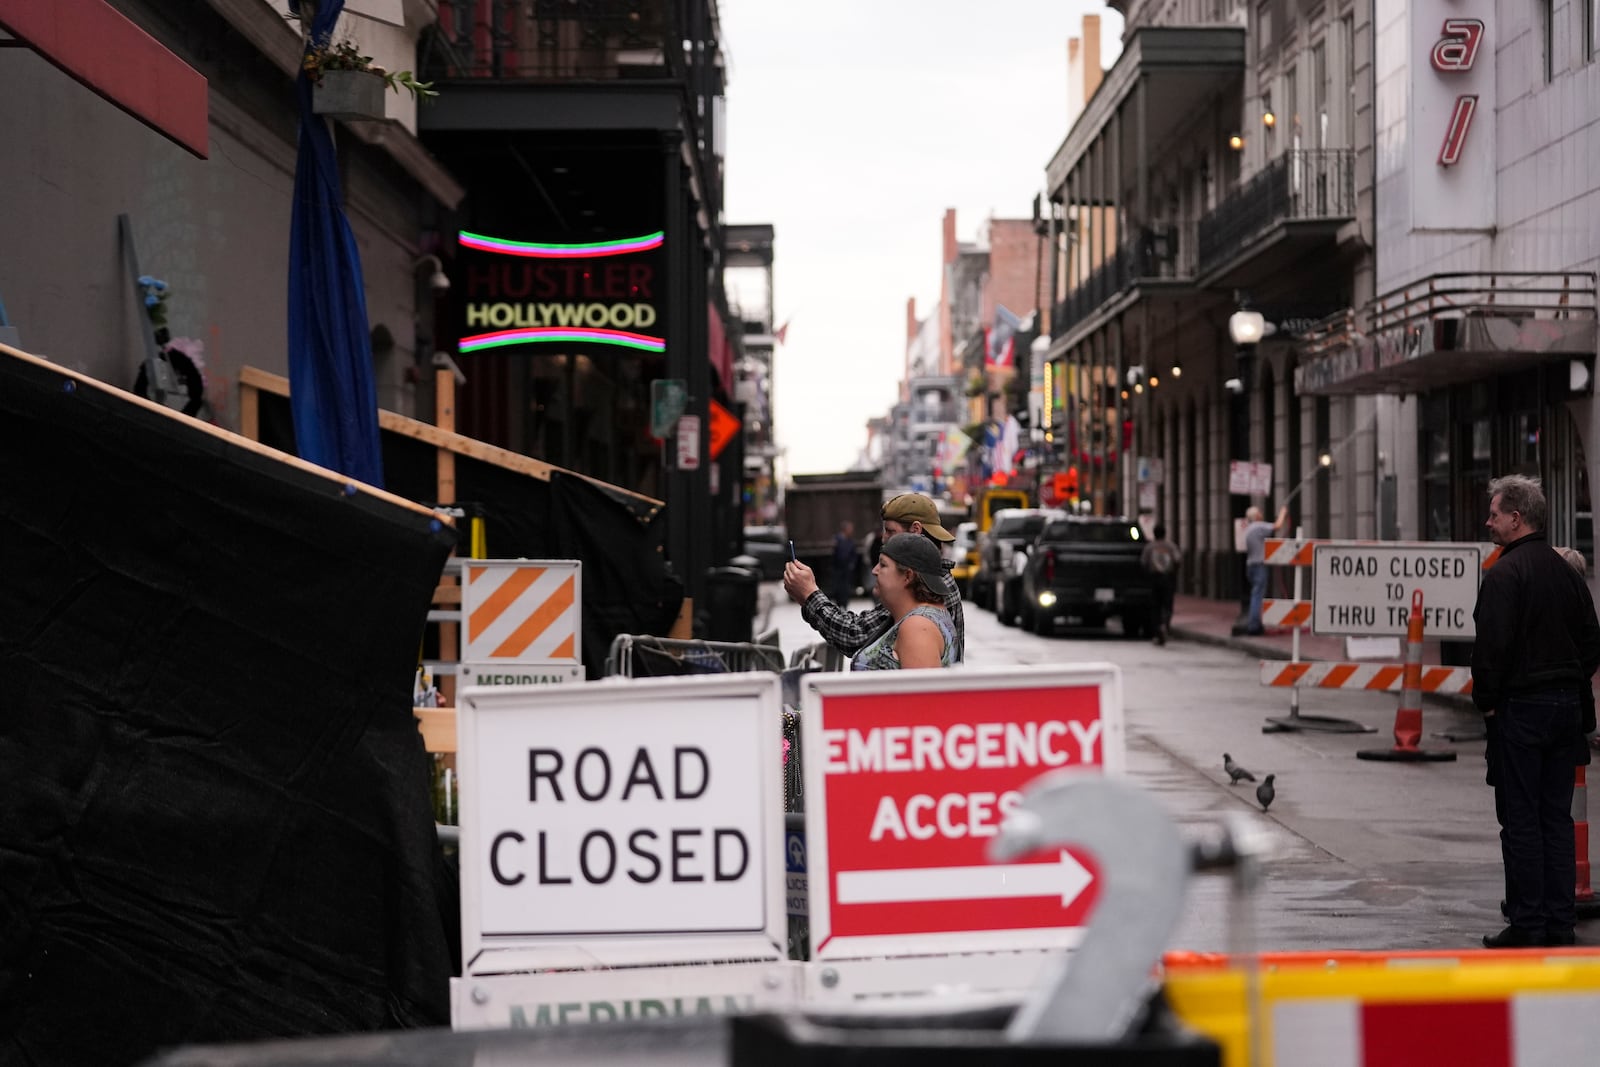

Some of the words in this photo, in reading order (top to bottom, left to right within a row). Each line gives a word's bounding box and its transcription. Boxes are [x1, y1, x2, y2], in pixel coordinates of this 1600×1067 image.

[467, 263, 653, 298] HUSTLER
[467, 303, 656, 327] HOLLYWOOD
[1331, 556, 1378, 576] ROAD
[1390, 557, 1465, 578] CLOSED
[1386, 583, 1404, 600] TO
[1328, 605, 1375, 625] THRU
[1387, 606, 1464, 628] TRFFIC
[477, 673, 563, 686] MERIDIAN
[822, 719, 1102, 774] EMERGENCY
[528, 746, 710, 801] ROAD
[869, 791, 1024, 840] ACCES
[489, 829, 749, 886] CLOSED
[786, 878, 808, 891] LICE
